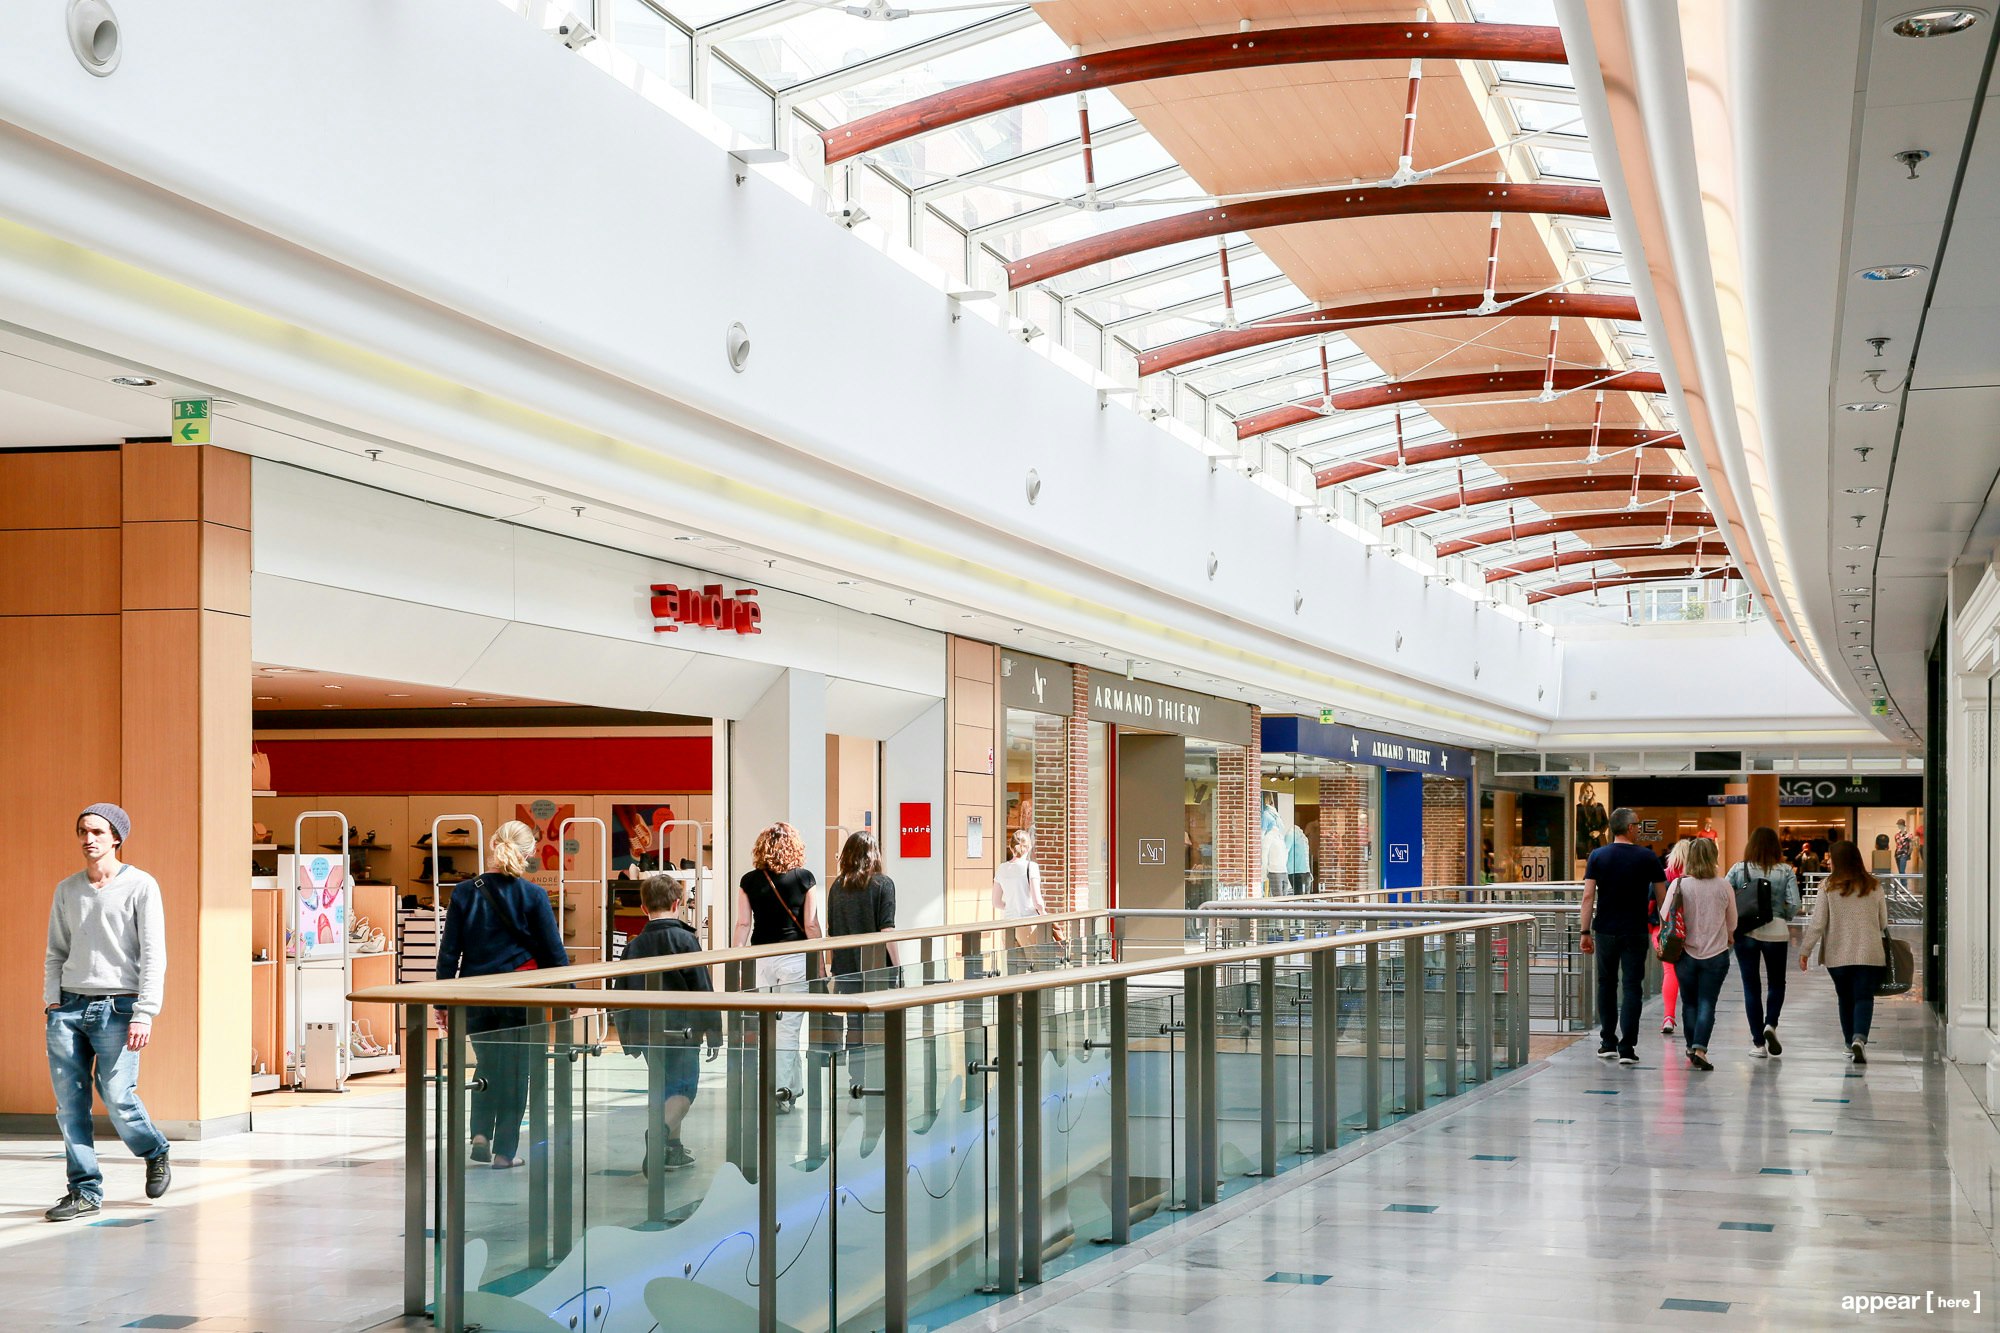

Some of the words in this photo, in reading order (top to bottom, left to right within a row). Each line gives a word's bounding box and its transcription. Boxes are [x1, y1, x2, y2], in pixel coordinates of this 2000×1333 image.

[1095, 685, 1153, 716] ARMAND
[1157, 698, 1201, 725] THIERY
[1372, 741, 1404, 761] ARMAND
[1406, 747, 1431, 765] THIERY
